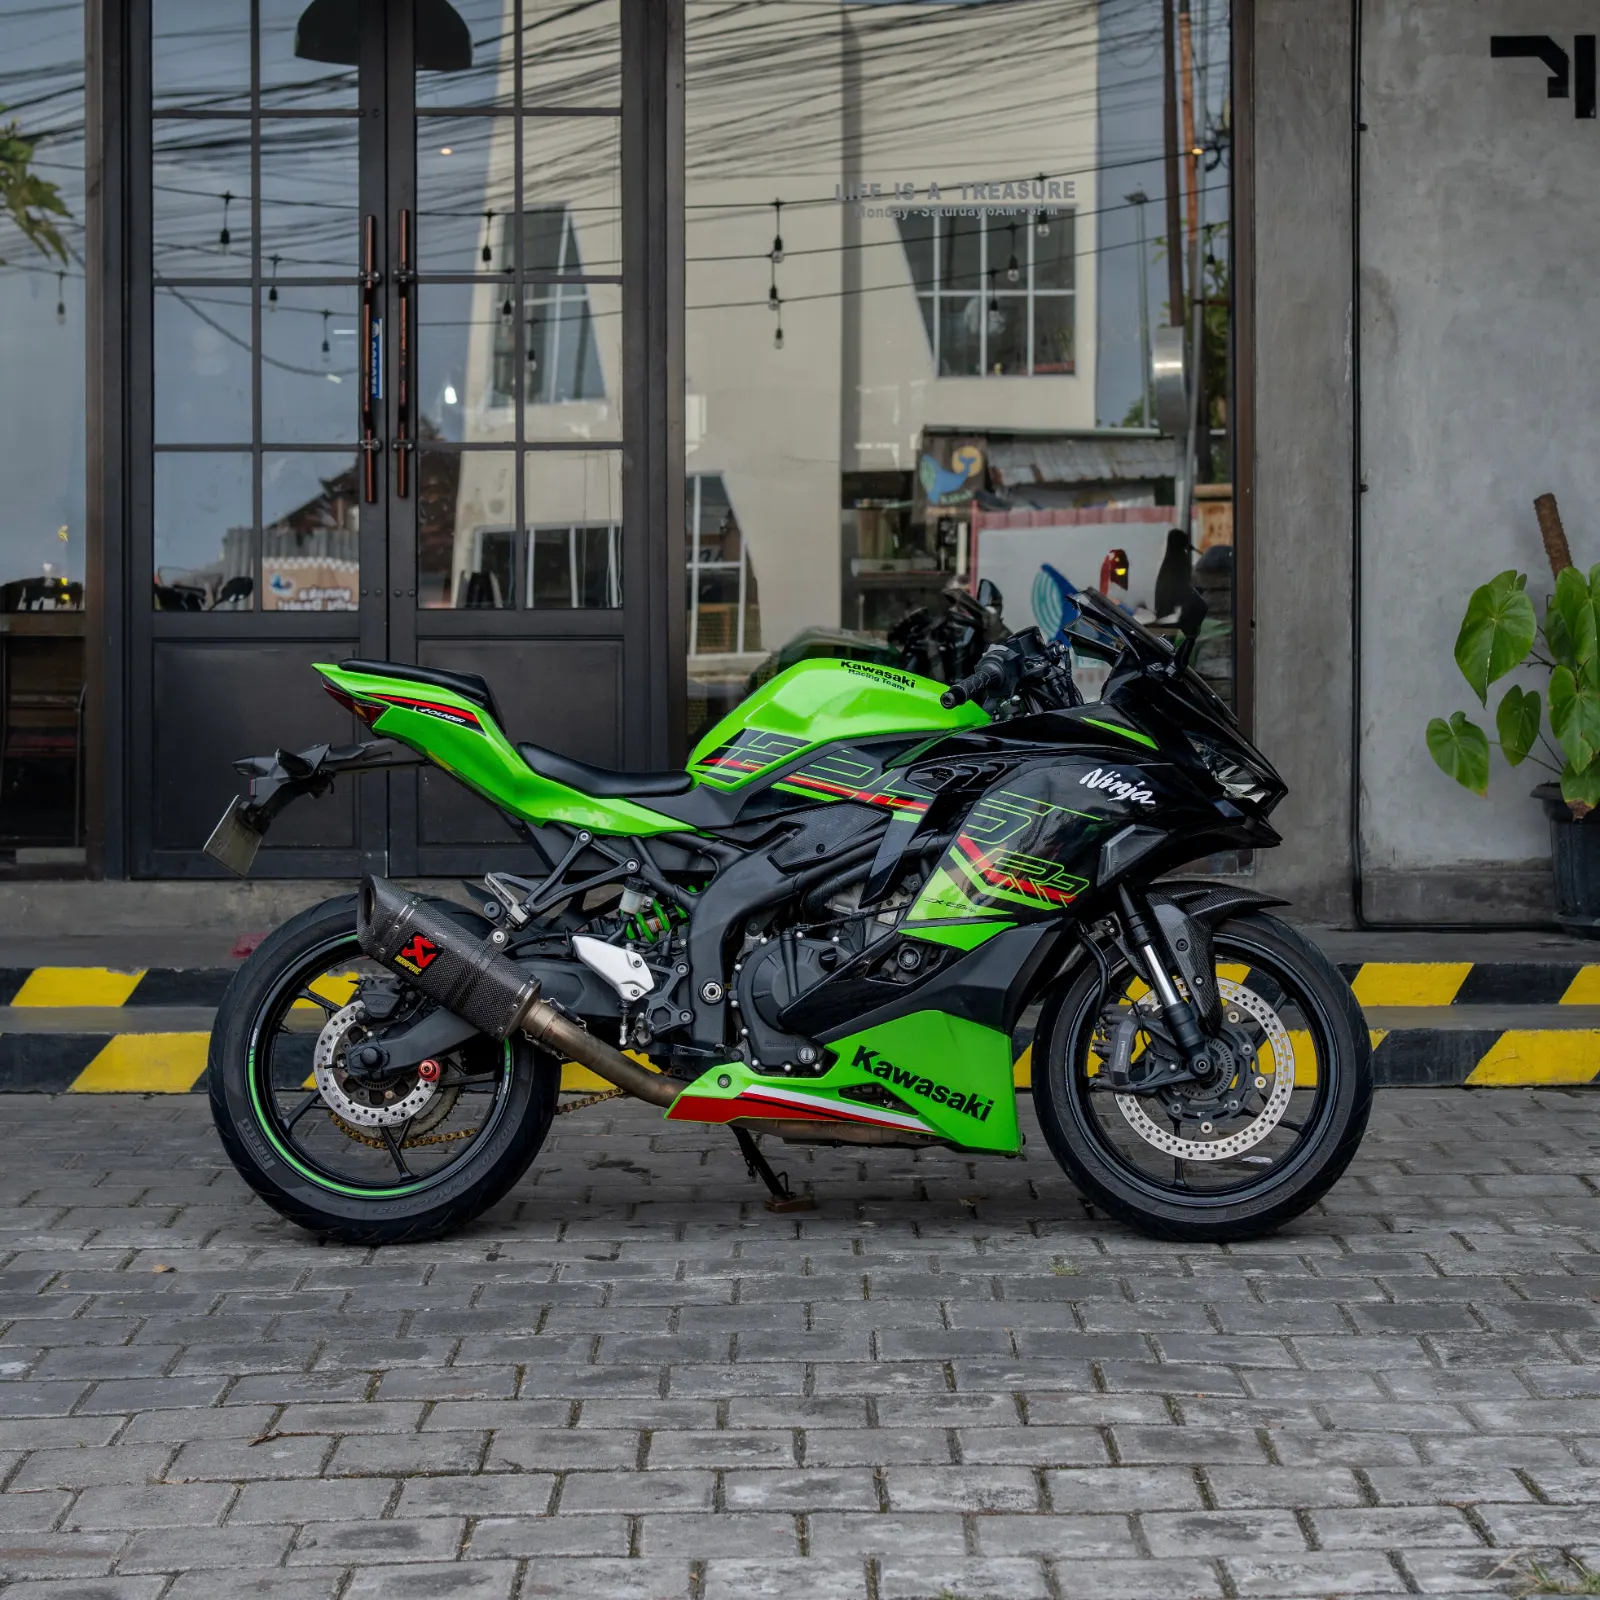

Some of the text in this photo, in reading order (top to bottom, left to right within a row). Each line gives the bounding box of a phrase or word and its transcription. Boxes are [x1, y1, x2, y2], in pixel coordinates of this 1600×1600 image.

[835, 180, 1076, 201] LIFE IS A TREASURE
[854, 205, 909, 220] Monday
[921, 203, 982, 220] Saturday
[840, 661, 915, 688] Kawasaki
[847, 668, 905, 691] Racing Team
[1079, 767, 1156, 804] Ninja
[851, 1045, 995, 1123] Kawasaki
[237, 1118, 276, 1170] PIRELLI
